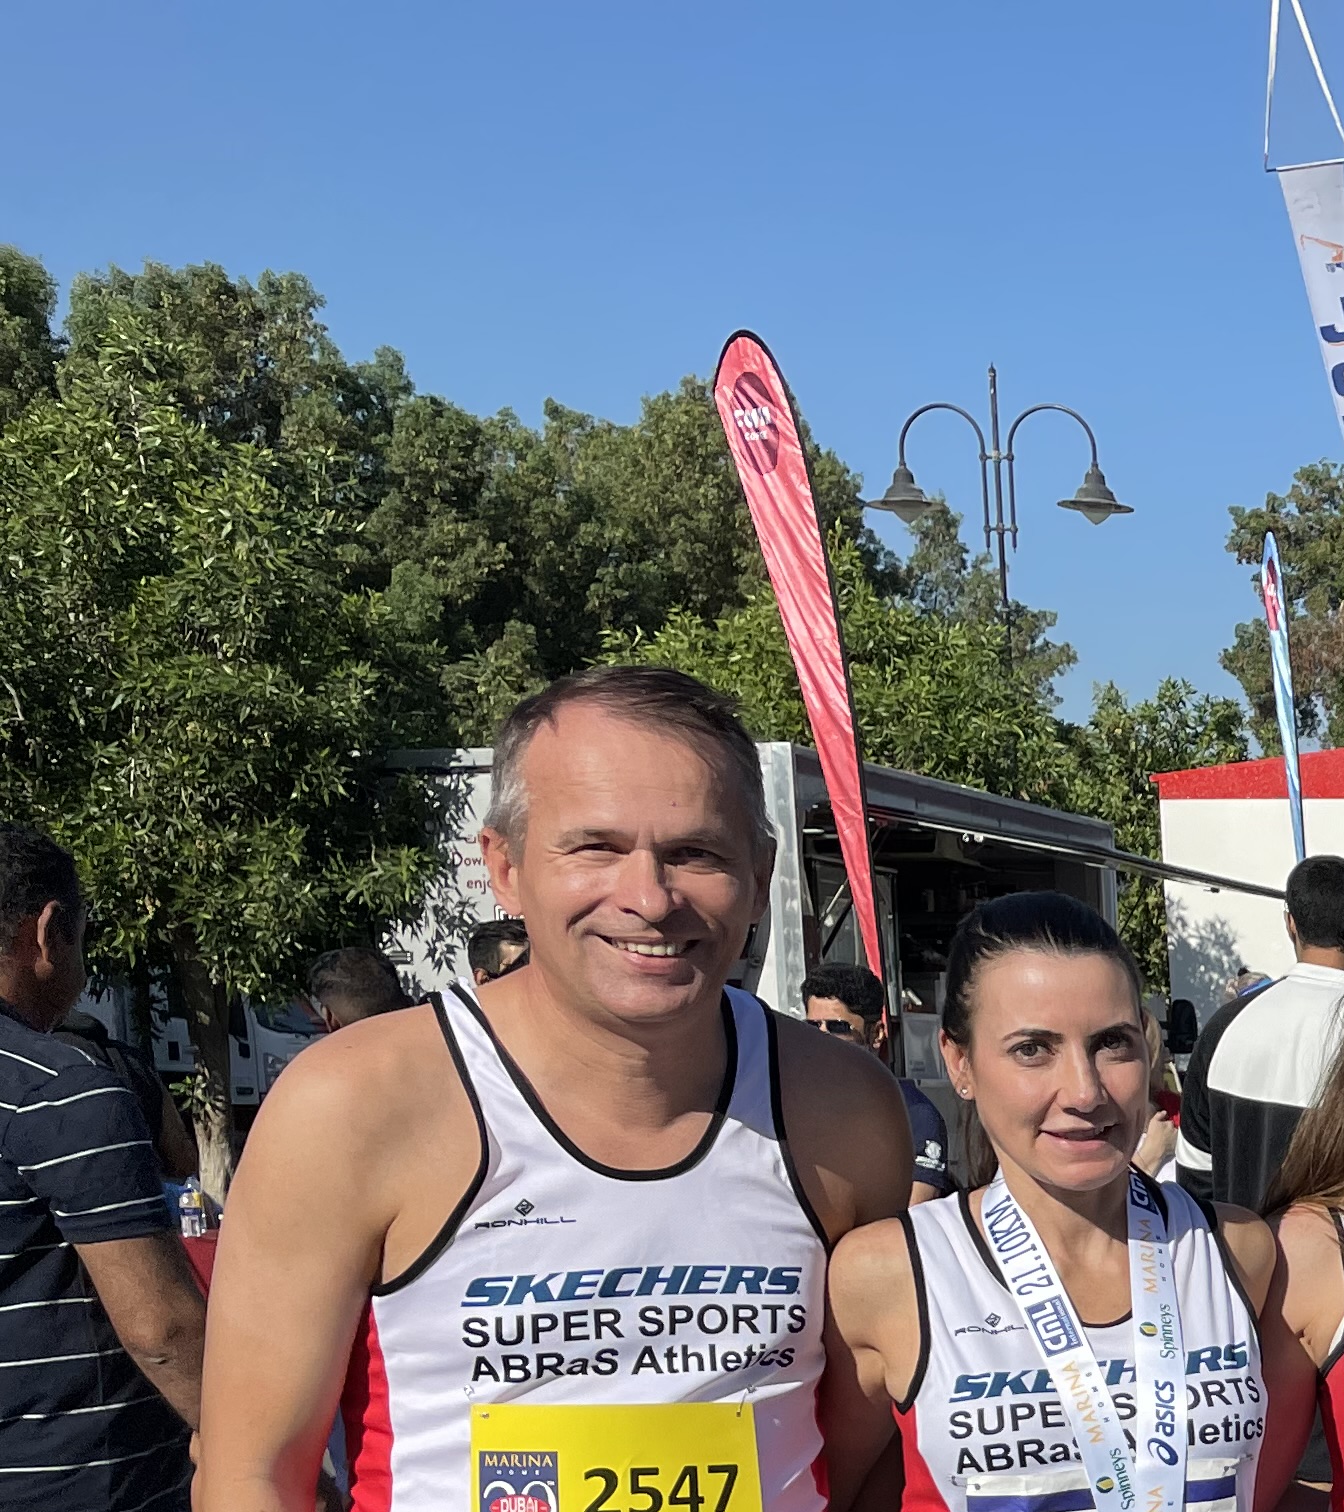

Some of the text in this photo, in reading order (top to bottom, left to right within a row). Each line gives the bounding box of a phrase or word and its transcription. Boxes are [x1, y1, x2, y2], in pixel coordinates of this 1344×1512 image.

[475, 1215, 578, 1230] RONHILL
[460, 1264, 804, 1308] SKECHERS
[462, 1303, 807, 1348] SUPER SPORTS
[1159, 1303, 1179, 1360] Spinneys
[471, 1343, 796, 1384] ABRaS Athletics
[949, 1400, 1064, 1440] SUPE
[1061, 1359, 1105, 1445] MARINA
[1154, 1379, 1176, 1438] asics
[484, 1453, 554, 1468] MARINA
